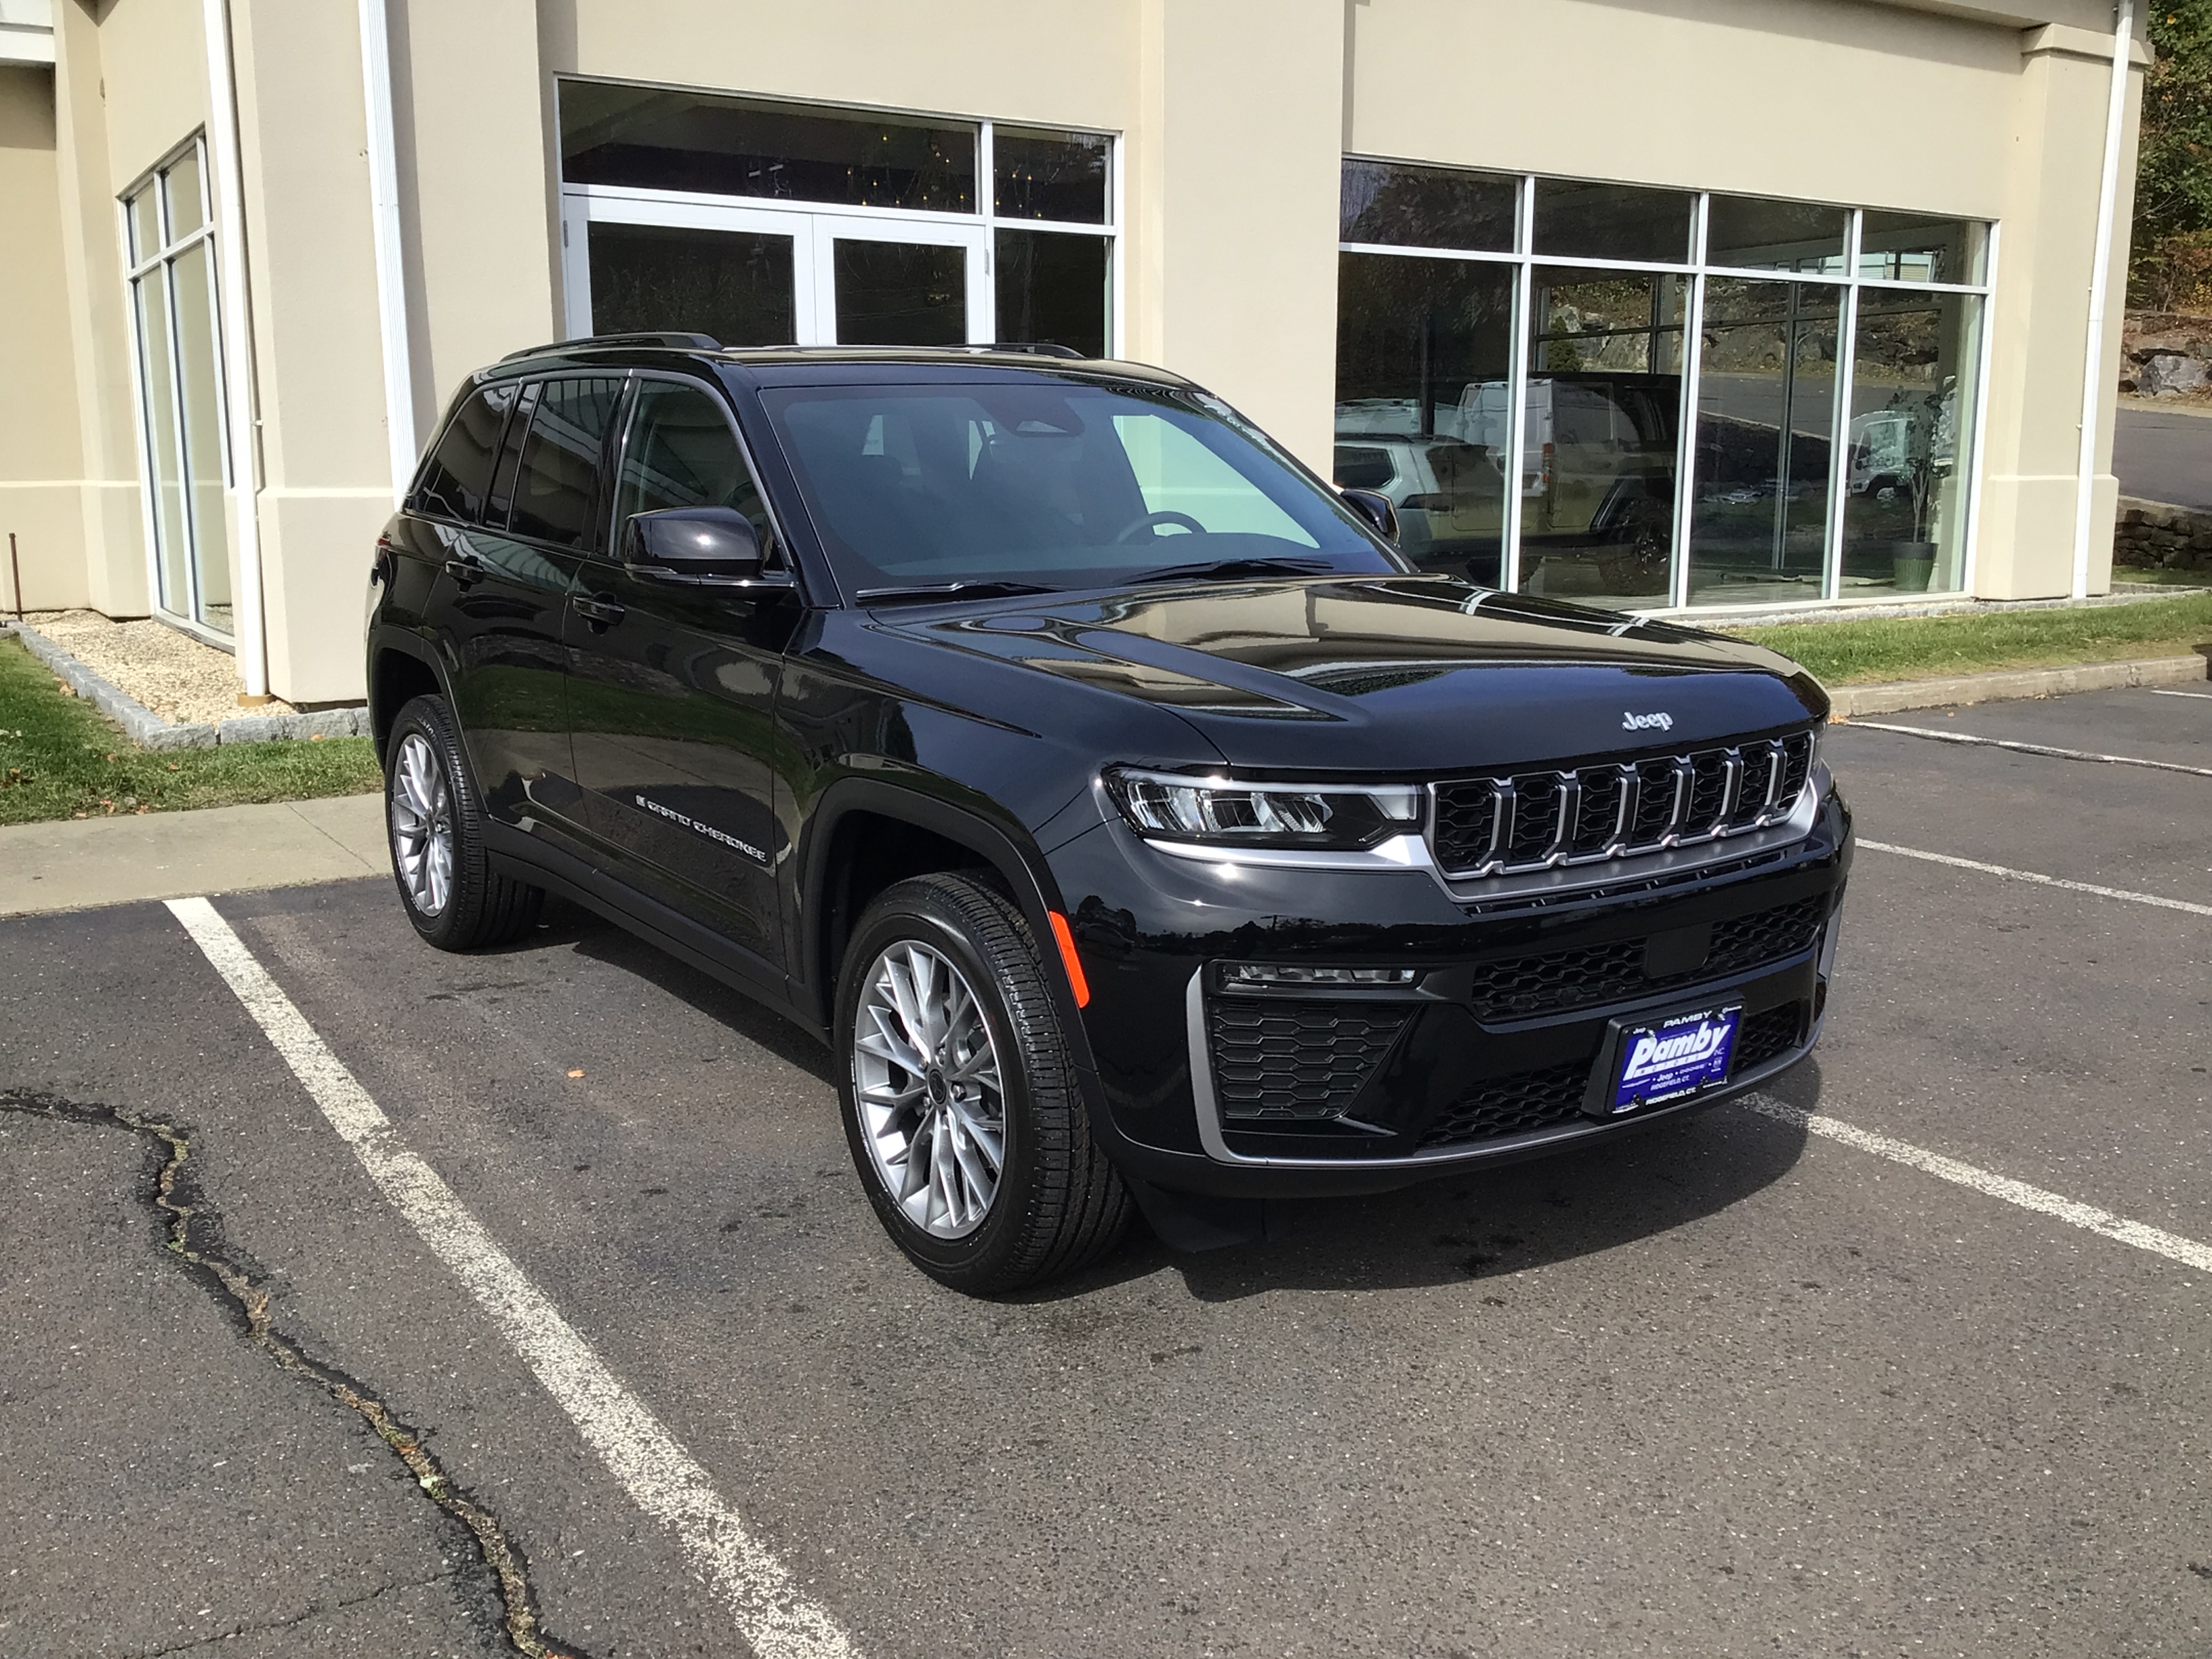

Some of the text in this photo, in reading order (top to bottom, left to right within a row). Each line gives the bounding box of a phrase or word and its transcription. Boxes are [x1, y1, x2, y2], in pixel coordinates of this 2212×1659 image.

[1621, 712, 1673, 731] Jeep
[647, 800, 767, 862] GRAND CHEROKEE
[1663, 1010, 1713, 1028] PAMBY
[1622, 1021, 1731, 1081] Pamby
[1657, 1072, 1674, 1082] Jeep
